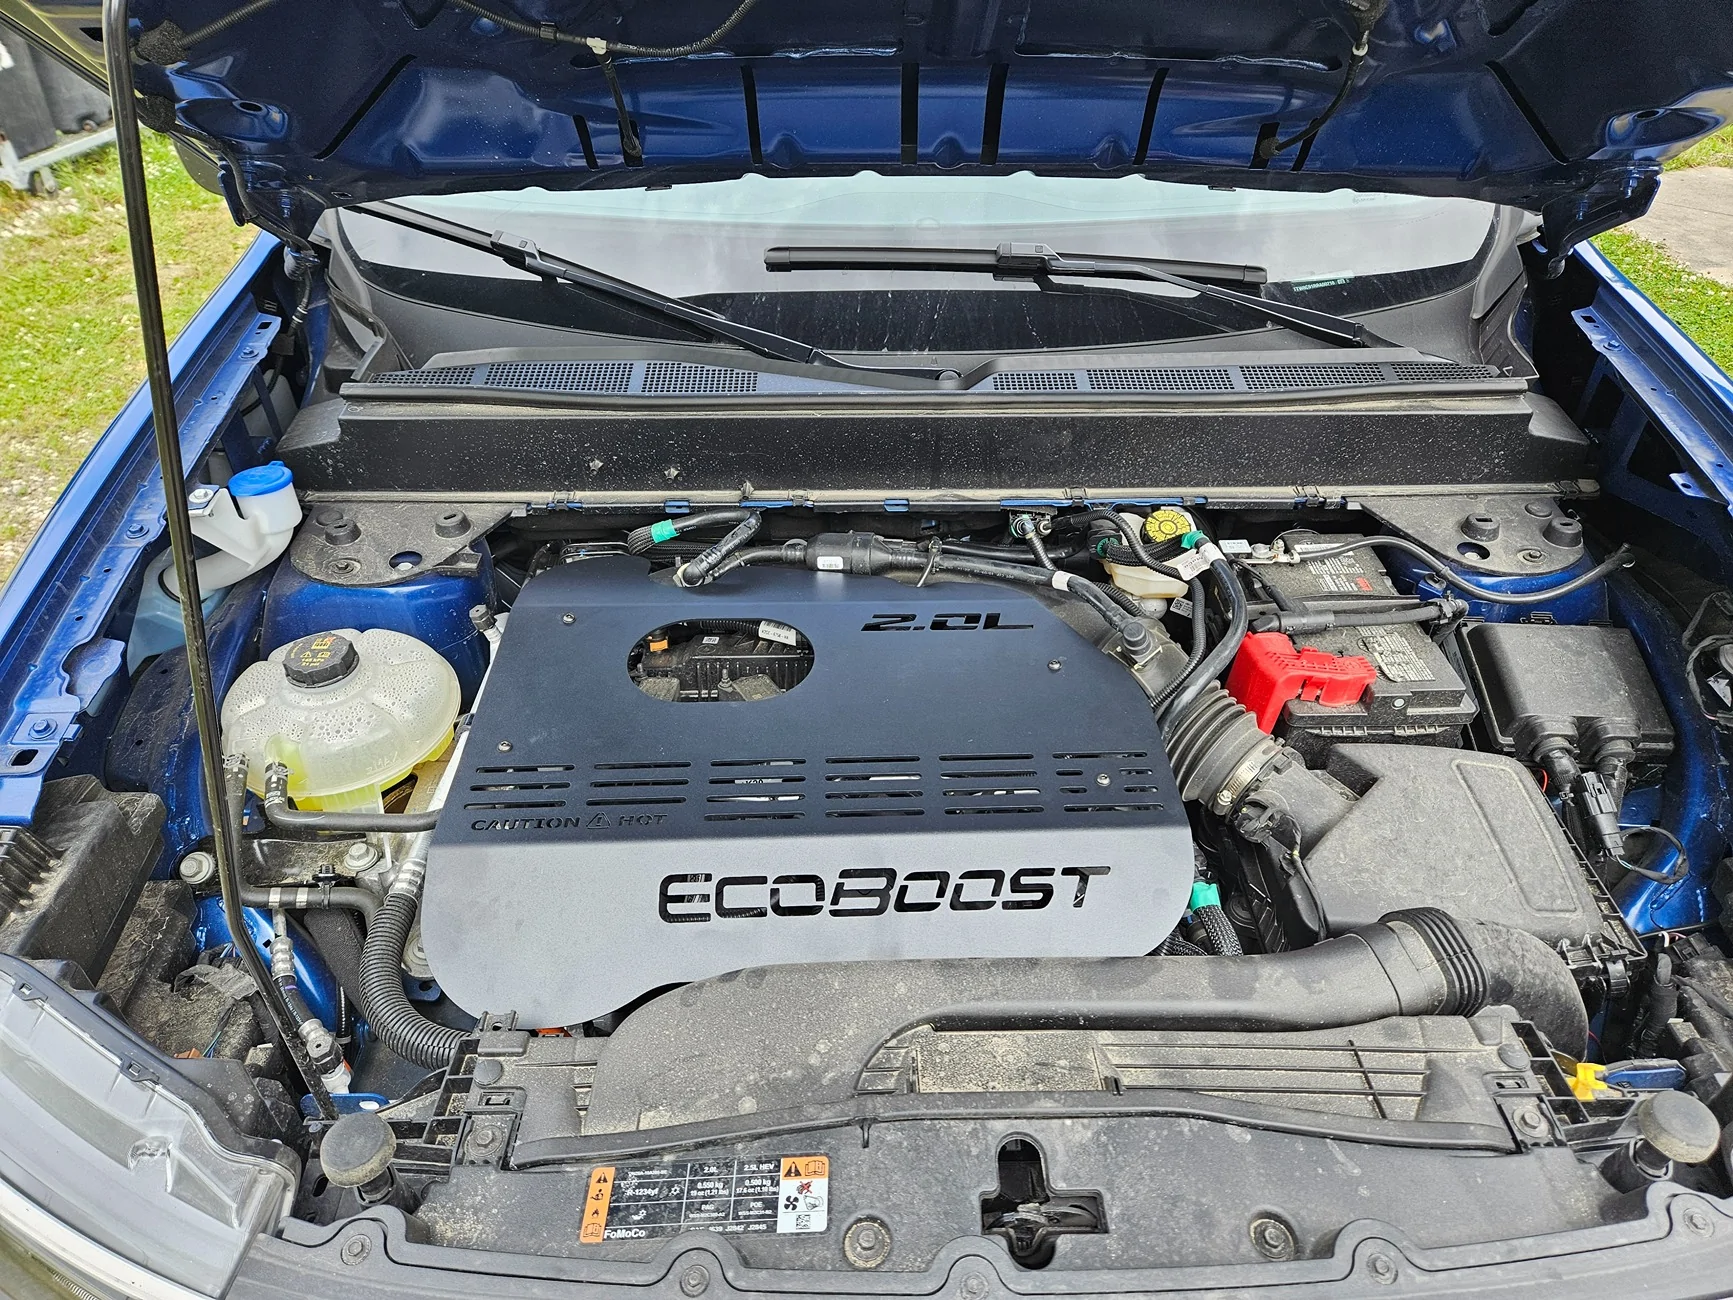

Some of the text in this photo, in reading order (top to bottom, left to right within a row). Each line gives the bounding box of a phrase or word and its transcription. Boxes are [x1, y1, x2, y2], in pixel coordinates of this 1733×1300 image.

[861, 612, 1034, 632] 2.0L
[471, 814, 668, 831] CAUTION HOT
[603, 1228, 646, 1239] FoMoCo
